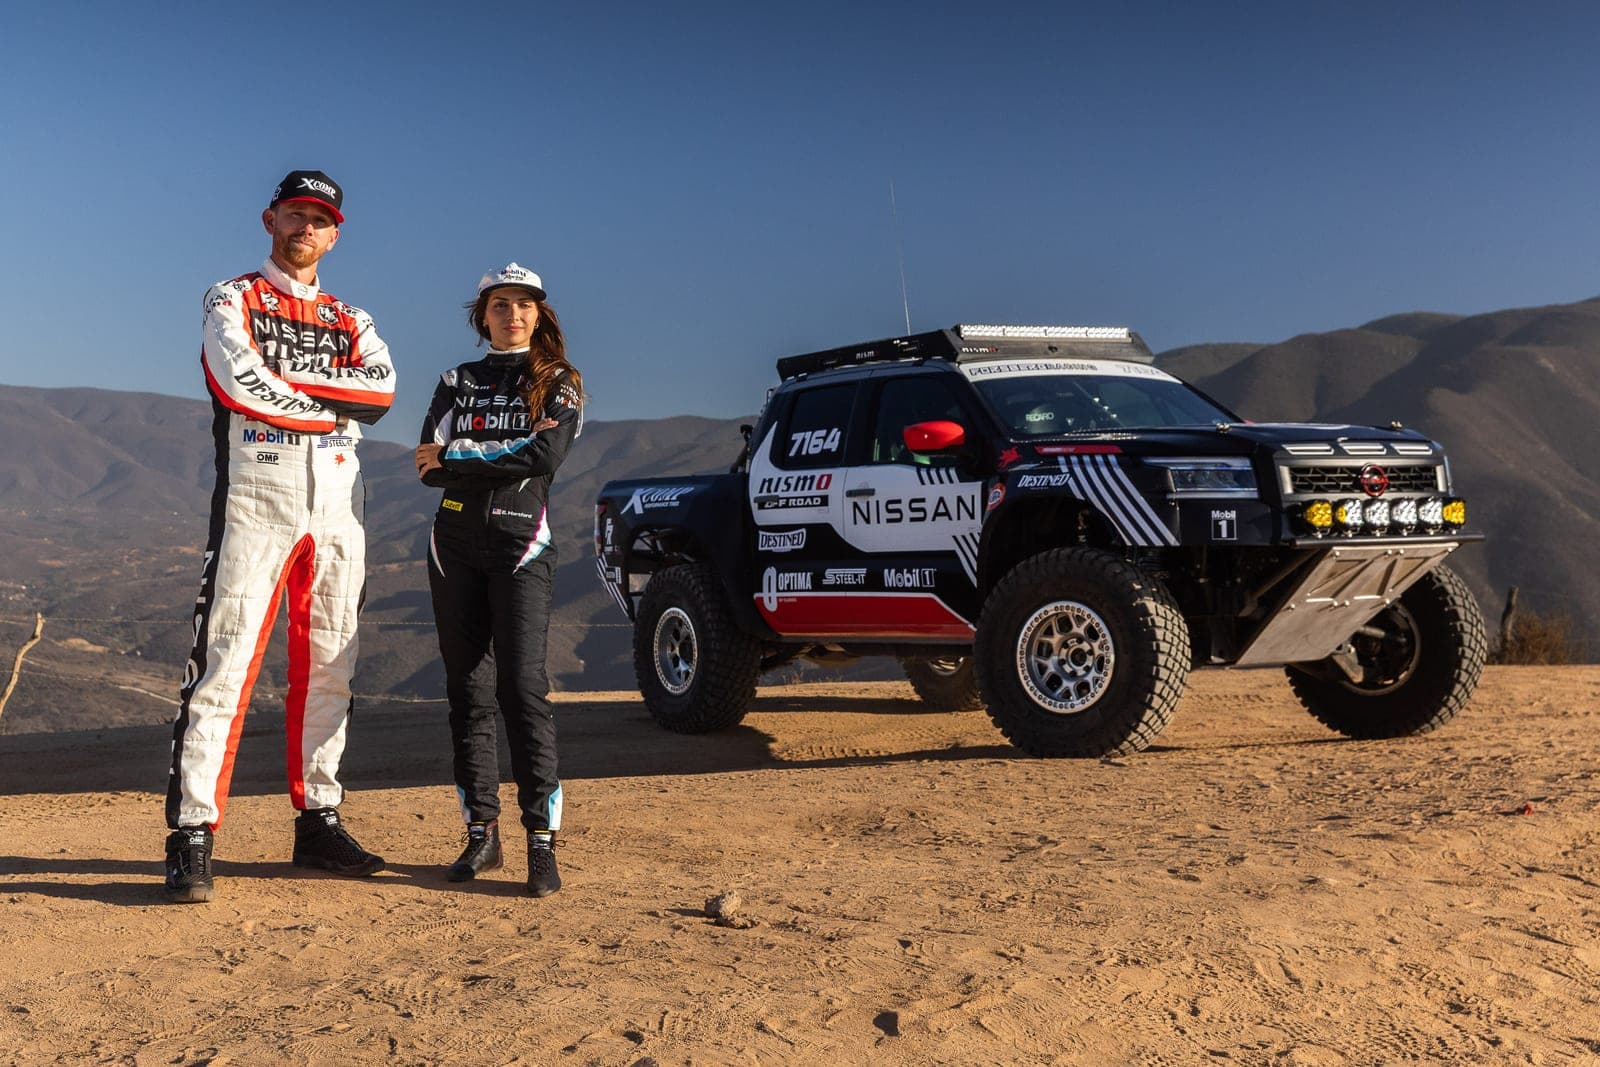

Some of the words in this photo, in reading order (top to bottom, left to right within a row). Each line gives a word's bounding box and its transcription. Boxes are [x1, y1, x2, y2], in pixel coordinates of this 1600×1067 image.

[454, 394, 533, 408] NISSA
[457, 412, 511, 433] Mobil
[242, 429, 284, 444] Mobil
[788, 427, 841, 457] 7164
[256, 453, 279, 463] OMP
[758, 473, 833, 494] nismo
[1017, 474, 1070, 487] DESTINED
[788, 497, 821, 507] ROAD
[852, 494, 976, 526] NISSAN
[1211, 510, 1237, 519] Mobil
[761, 530, 805, 549] DESTINED
[778, 572, 813, 590] OPTIMA
[836, 573, 866, 585] STEEL-IT
[883, 568, 920, 587] Mobil
